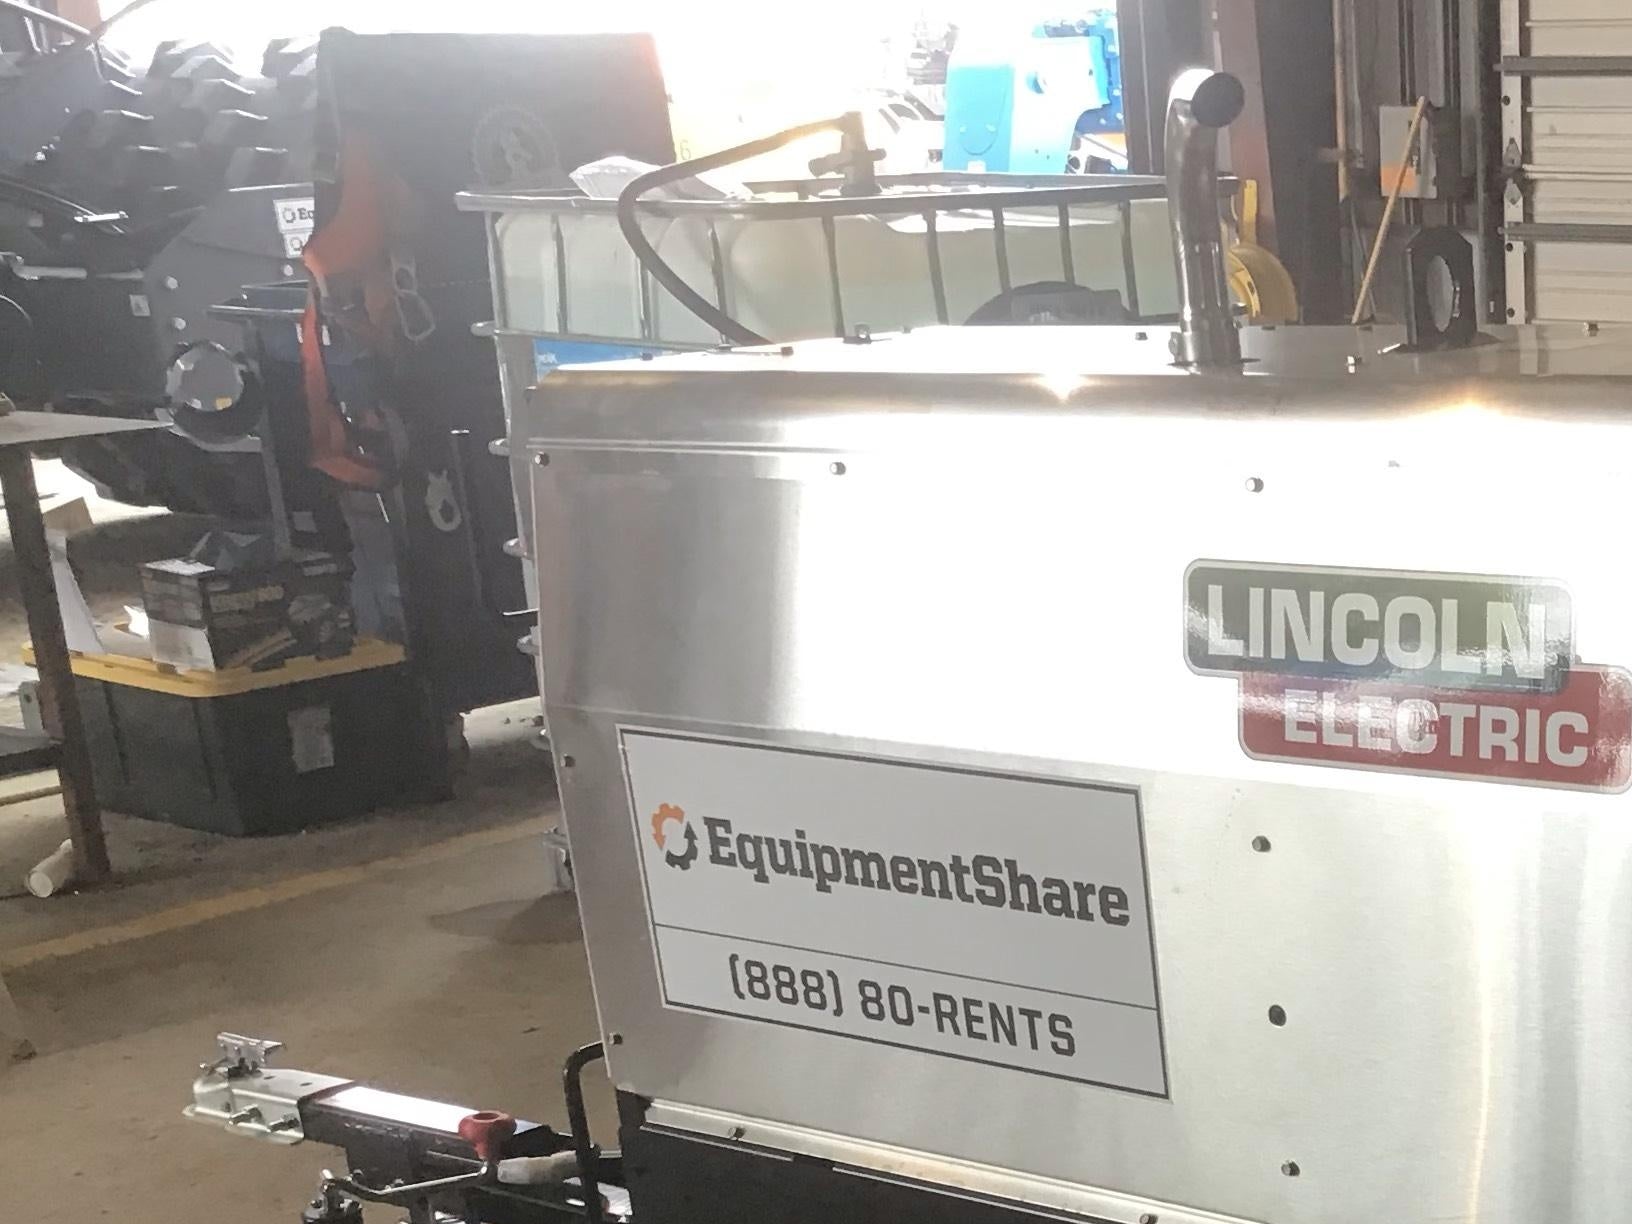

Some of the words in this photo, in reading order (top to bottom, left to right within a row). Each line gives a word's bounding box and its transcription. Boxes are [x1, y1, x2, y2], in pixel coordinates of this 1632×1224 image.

[1207, 584, 1547, 680] LINCOLN
[1283, 687, 1589, 768] ELECTRIC
[703, 816, 1131, 926] EquipmentShare
[729, 953, 844, 1017] (888)
[858, 979, 1077, 1057] 80-RENTS
